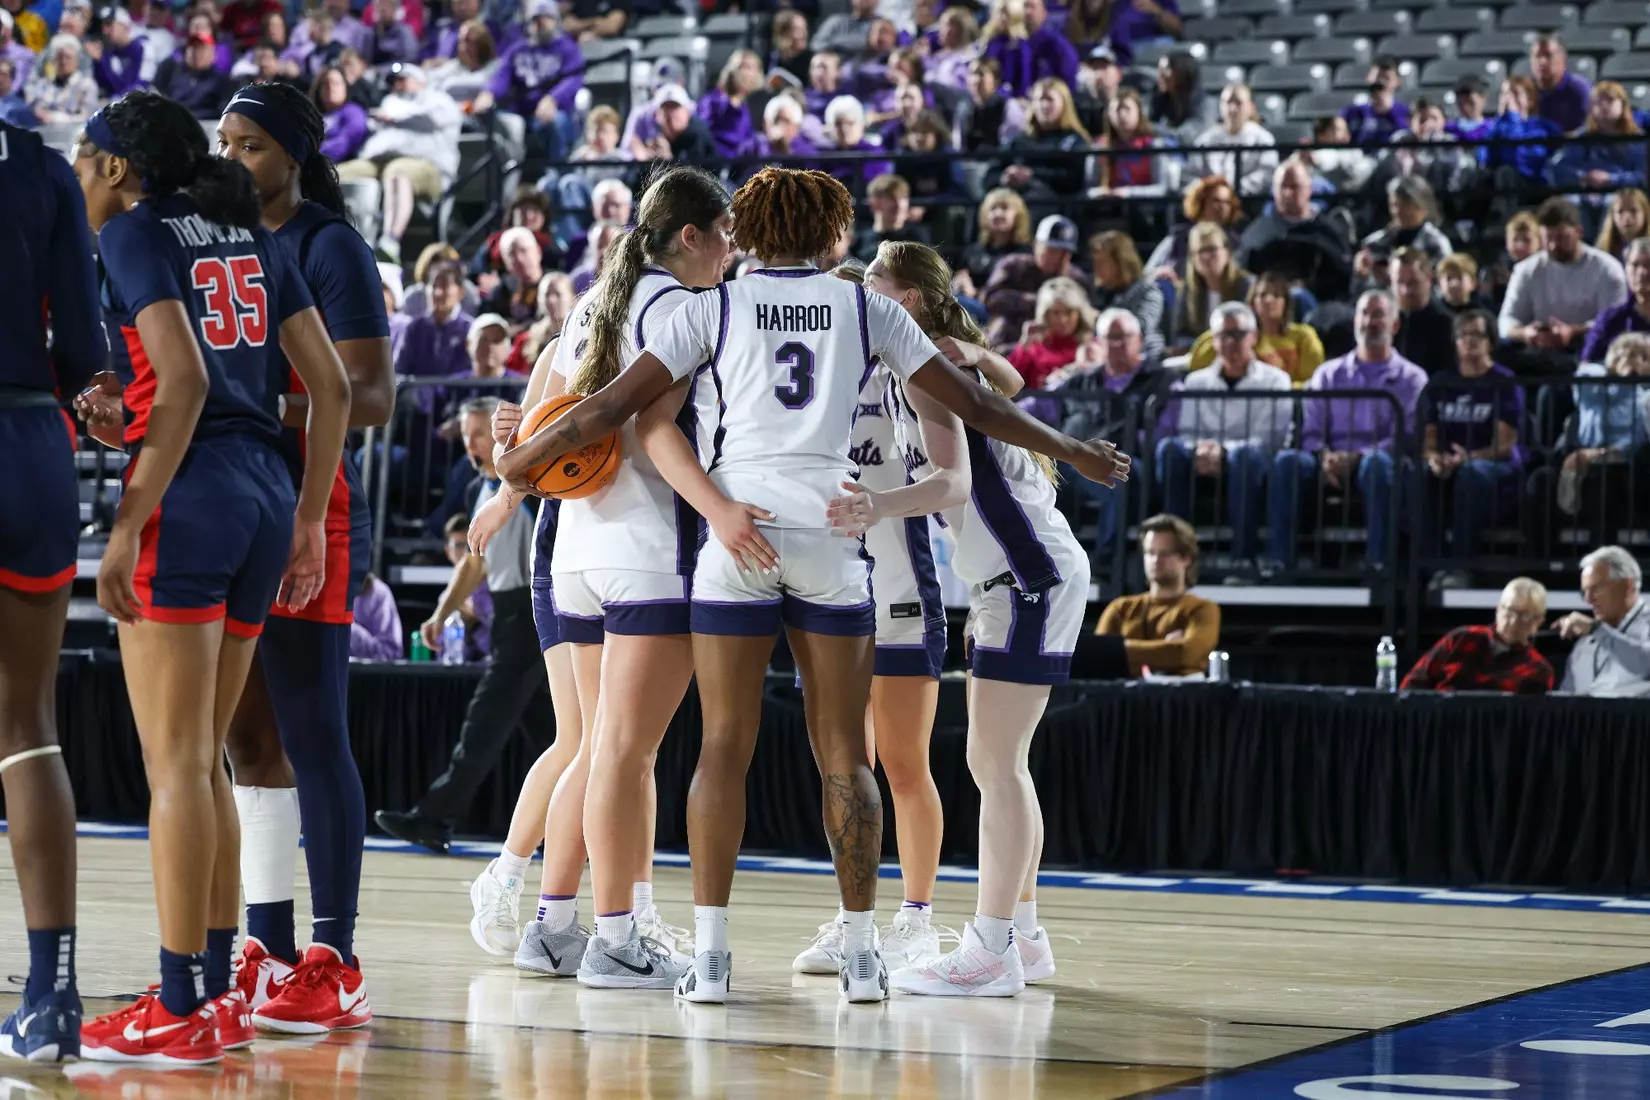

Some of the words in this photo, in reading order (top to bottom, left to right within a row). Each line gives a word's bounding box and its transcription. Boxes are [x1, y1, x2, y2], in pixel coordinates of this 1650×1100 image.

[190, 254, 267, 350] 35
[756, 303, 832, 332] HARROD
[774, 341, 815, 410] 3
